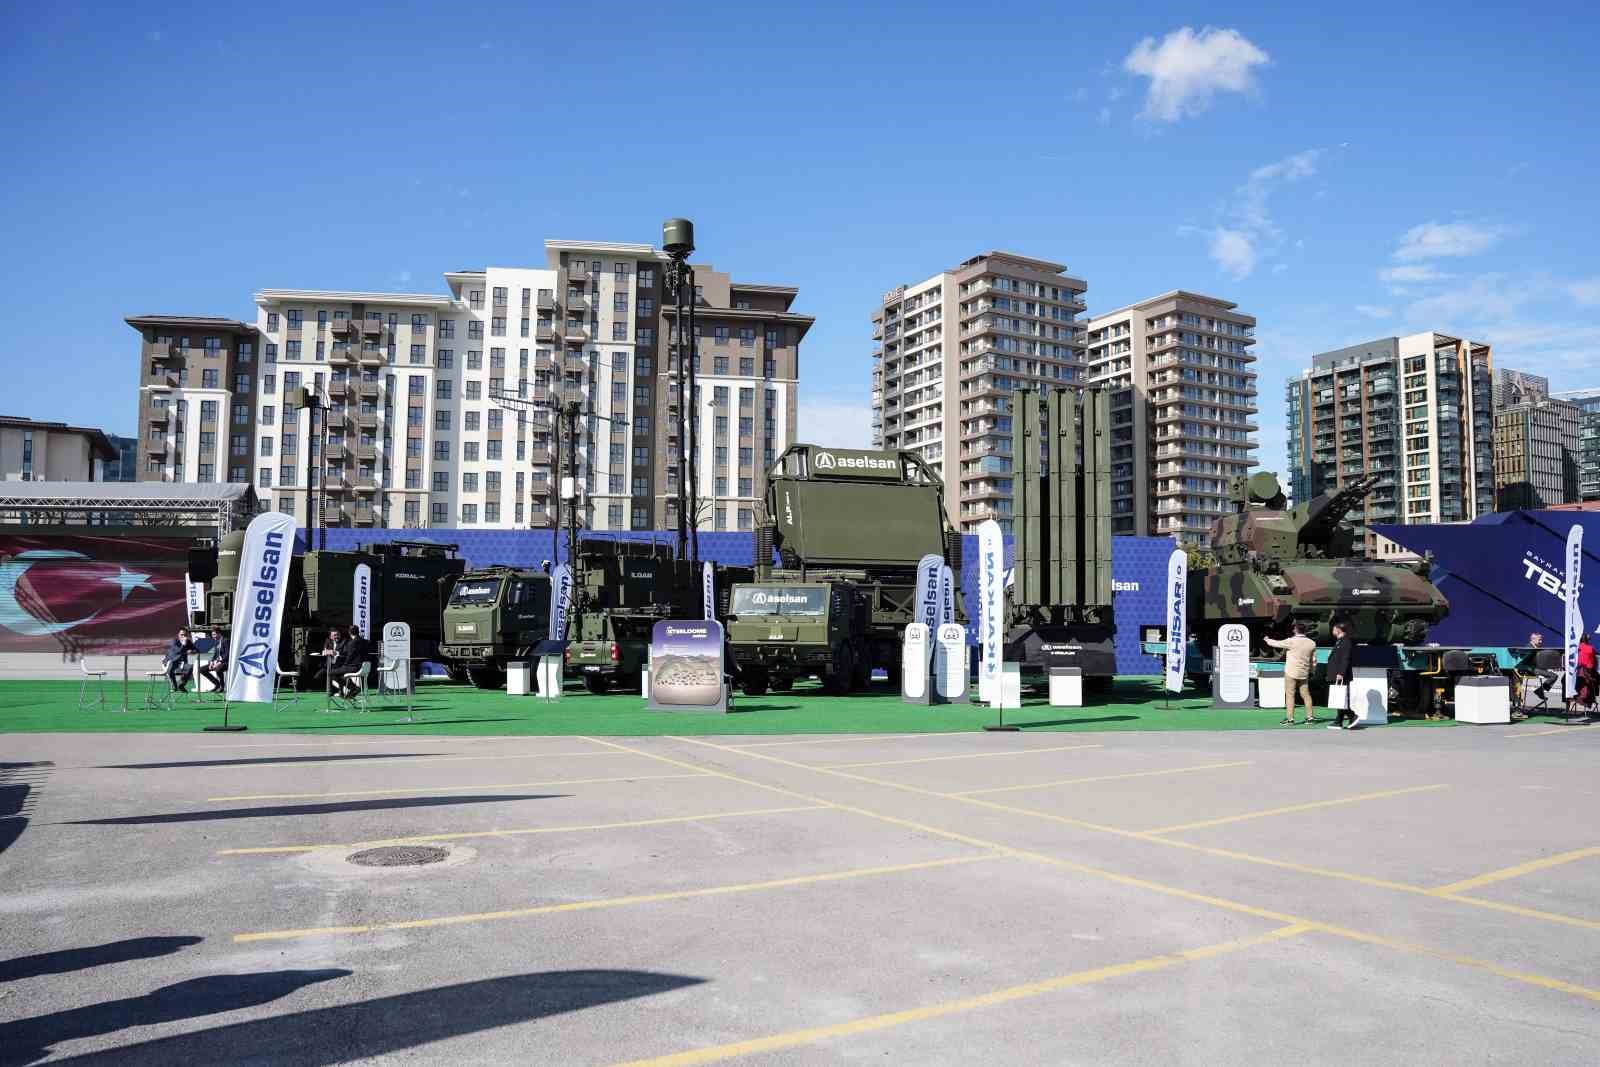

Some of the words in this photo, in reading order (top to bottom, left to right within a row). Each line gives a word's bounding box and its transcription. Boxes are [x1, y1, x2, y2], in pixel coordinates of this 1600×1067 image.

[837, 455, 897, 471] aselsan
[252, 532, 283, 638] aselsan
[1112, 579, 1140, 592] lsan
[767, 592, 808, 604] aselsan
